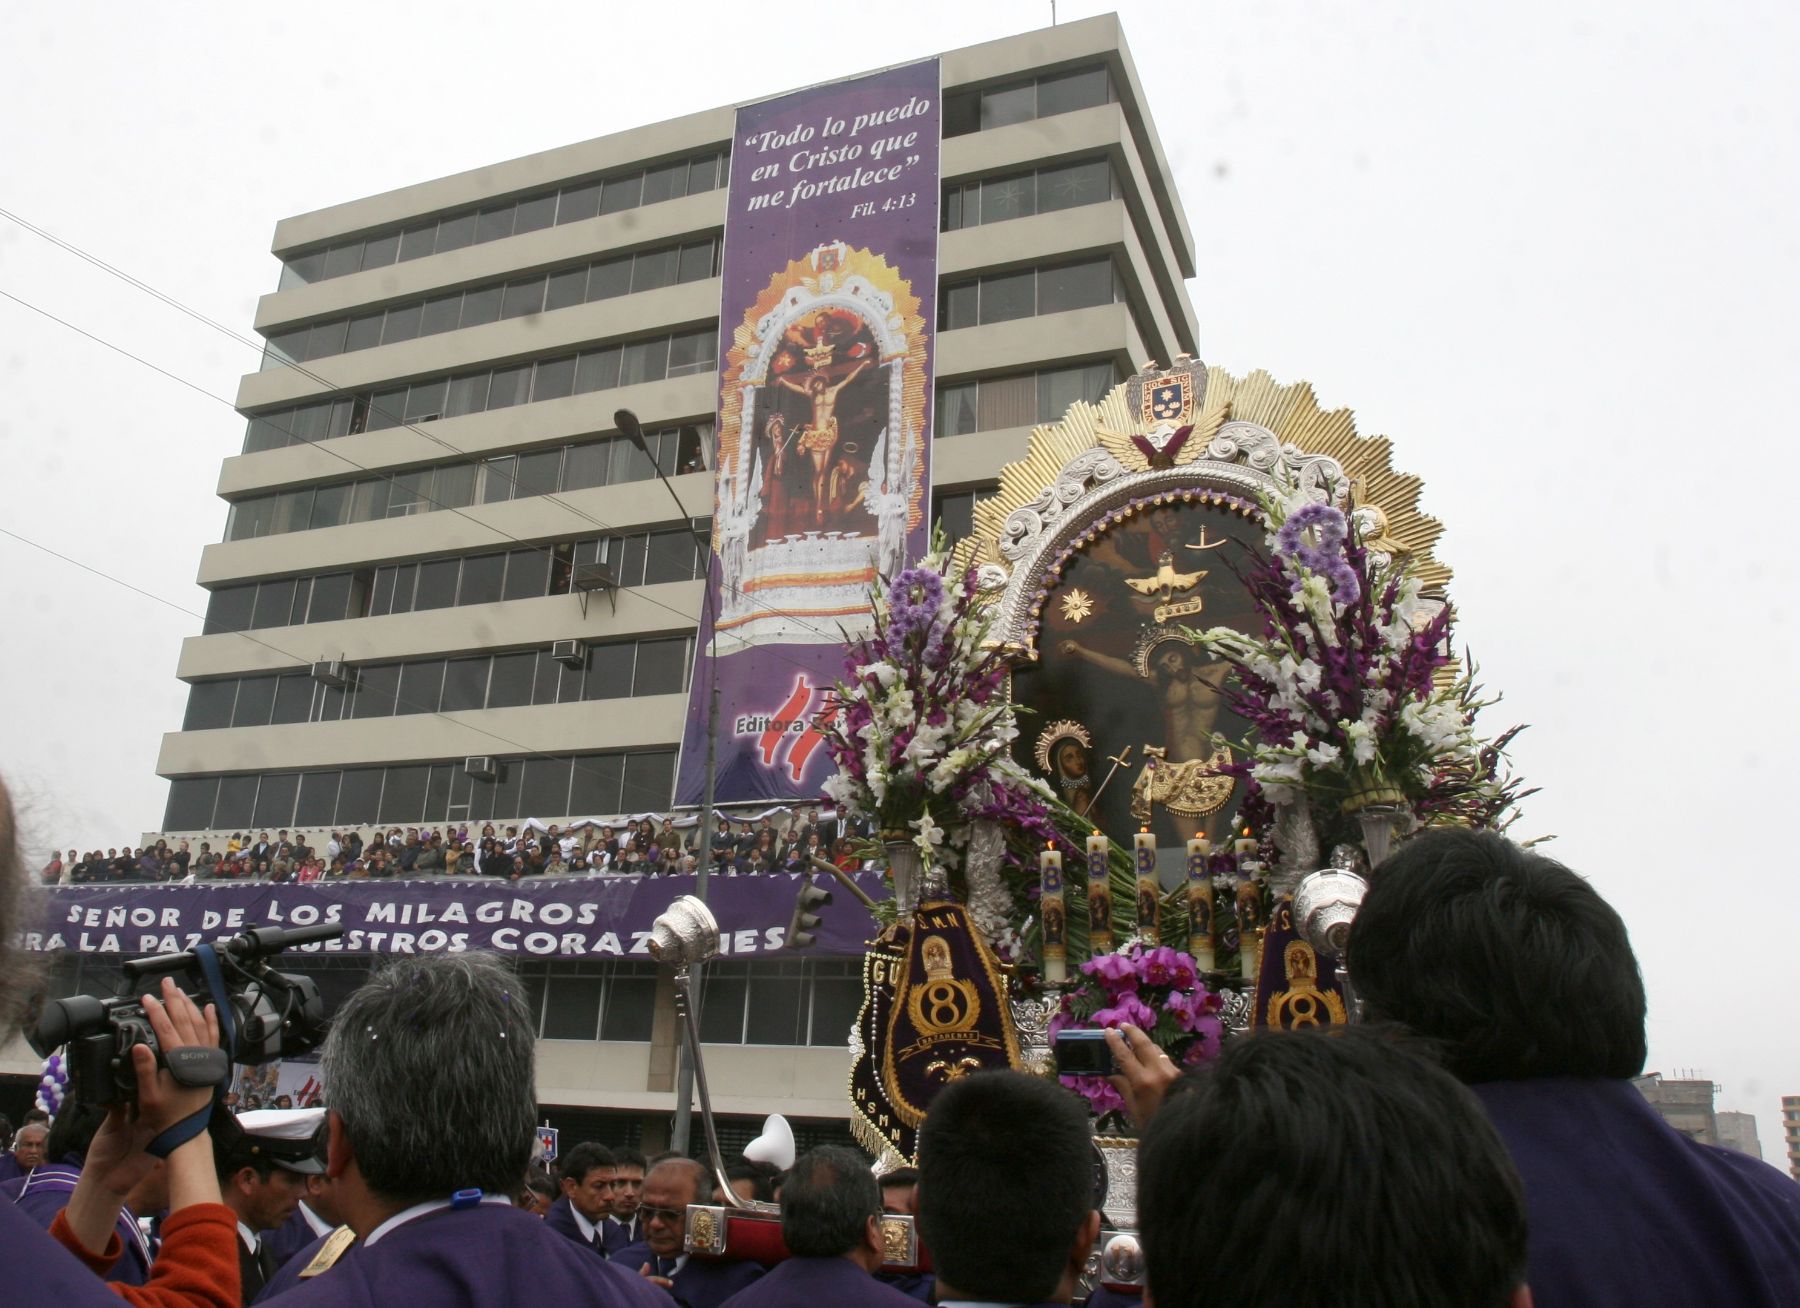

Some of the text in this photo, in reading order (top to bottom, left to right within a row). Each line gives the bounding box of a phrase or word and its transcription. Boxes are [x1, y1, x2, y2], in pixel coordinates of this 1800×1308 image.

[822, 116, 845, 138] lo
[850, 96, 930, 137] puedo
[751, 131, 918, 182] en Cristo que
[747, 190, 785, 212] me
[849, 192, 916, 219] Fil. 4:13
[736, 716, 804, 734] Editora
[66, 898, 599, 930] SEÑOR DE LOS MILAGROS
[80, 932, 120, 952] LA
[491, 926, 785, 956] CORAZES
[929, 981, 959, 1027] 8
